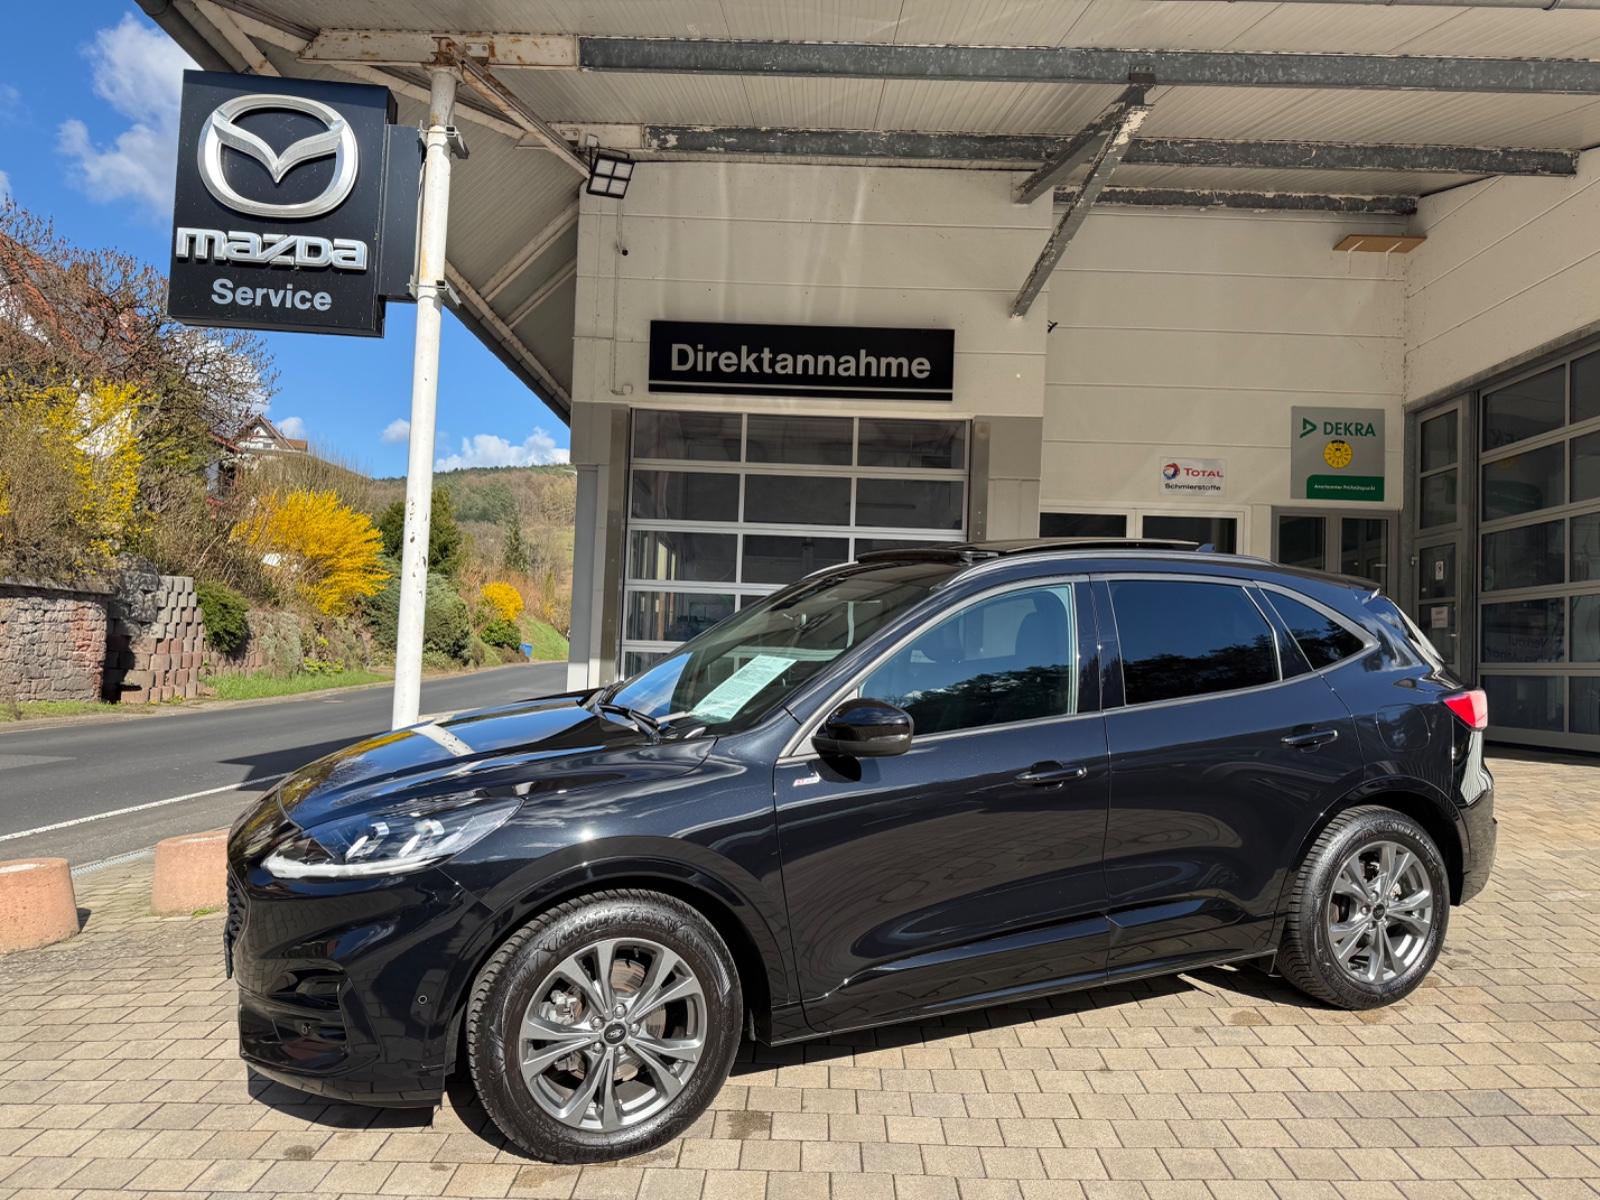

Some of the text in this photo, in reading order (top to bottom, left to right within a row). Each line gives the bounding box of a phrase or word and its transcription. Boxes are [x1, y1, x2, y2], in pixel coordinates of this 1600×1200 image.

[175, 227, 368, 270] mazda
[211, 278, 332, 310] Service
[671, 343, 931, 379] Direktannahme
[1323, 421, 1376, 437] DEKRA
[1183, 467, 1224, 478] TOTAL
[1164, 483, 1221, 491] Schmierstoffe
